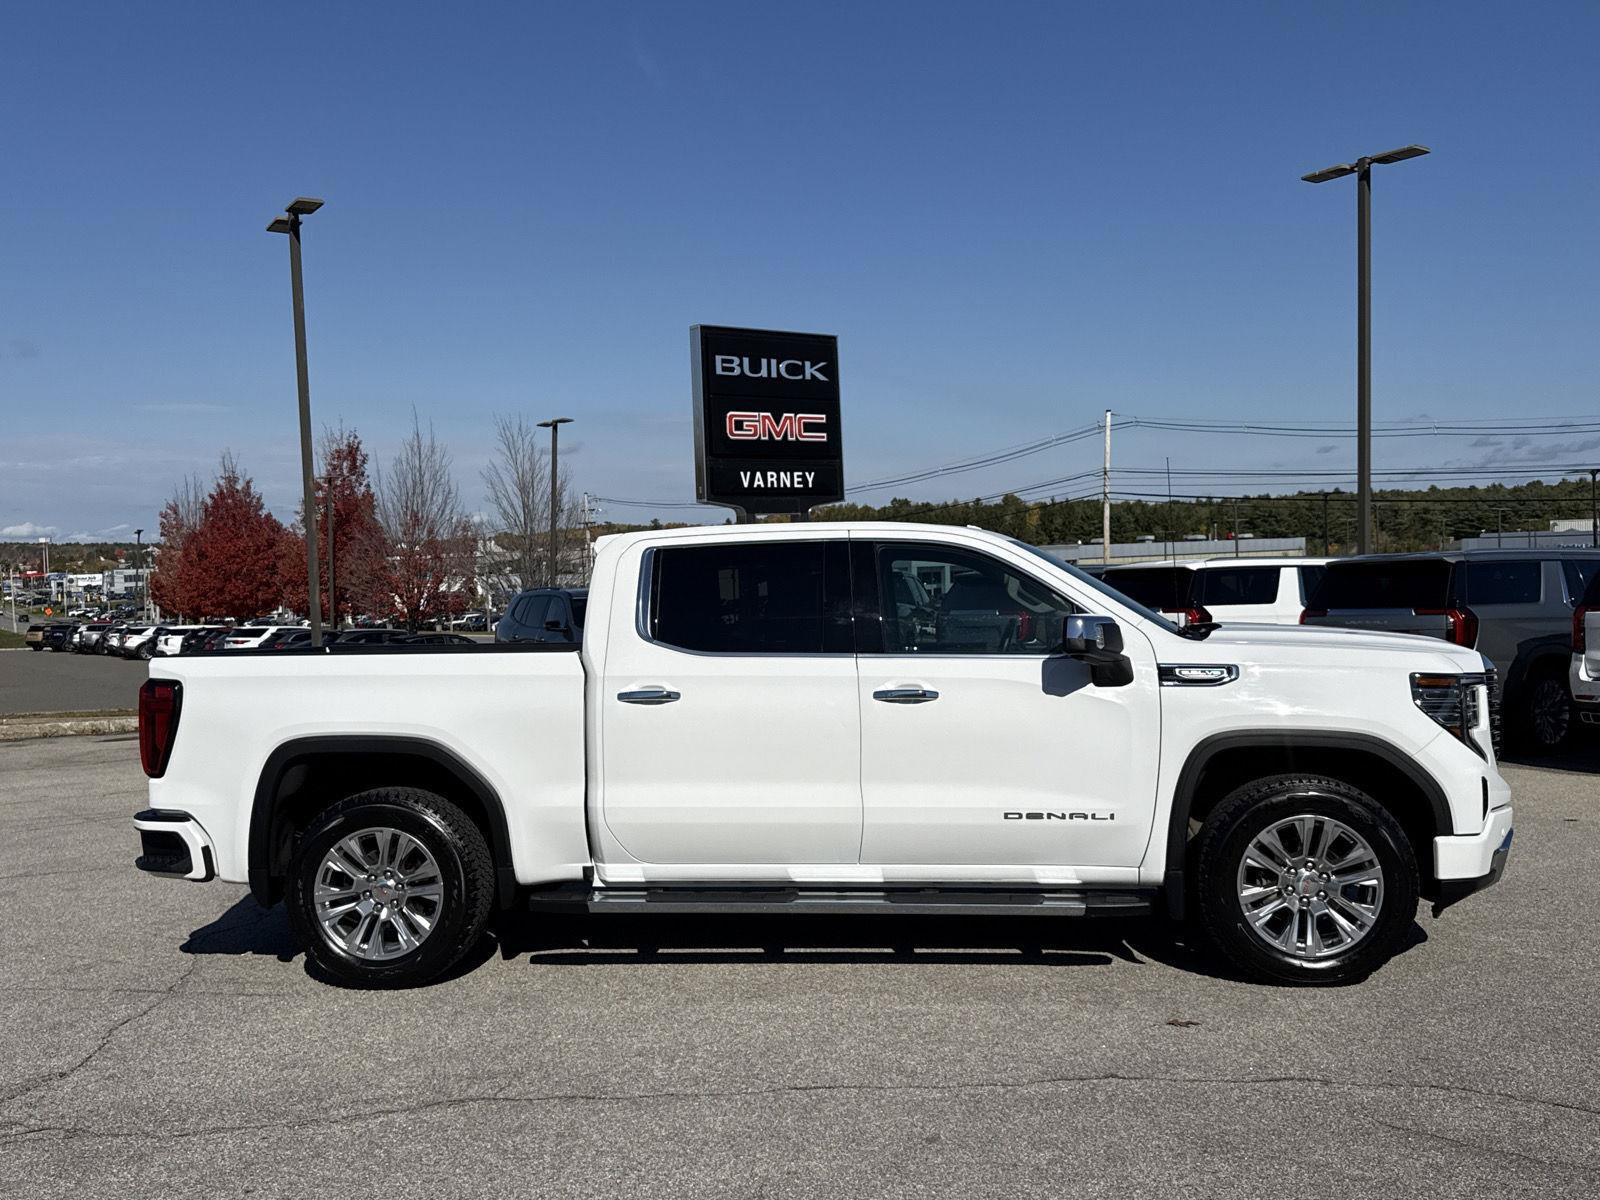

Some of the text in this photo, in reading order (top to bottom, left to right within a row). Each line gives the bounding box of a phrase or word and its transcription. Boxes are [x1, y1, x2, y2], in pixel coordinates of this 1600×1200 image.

[715, 355, 829, 381] BUICK
[726, 411, 827, 441] GMC
[740, 471, 816, 488] VARNEY
[1003, 812, 1115, 820] DENALI
